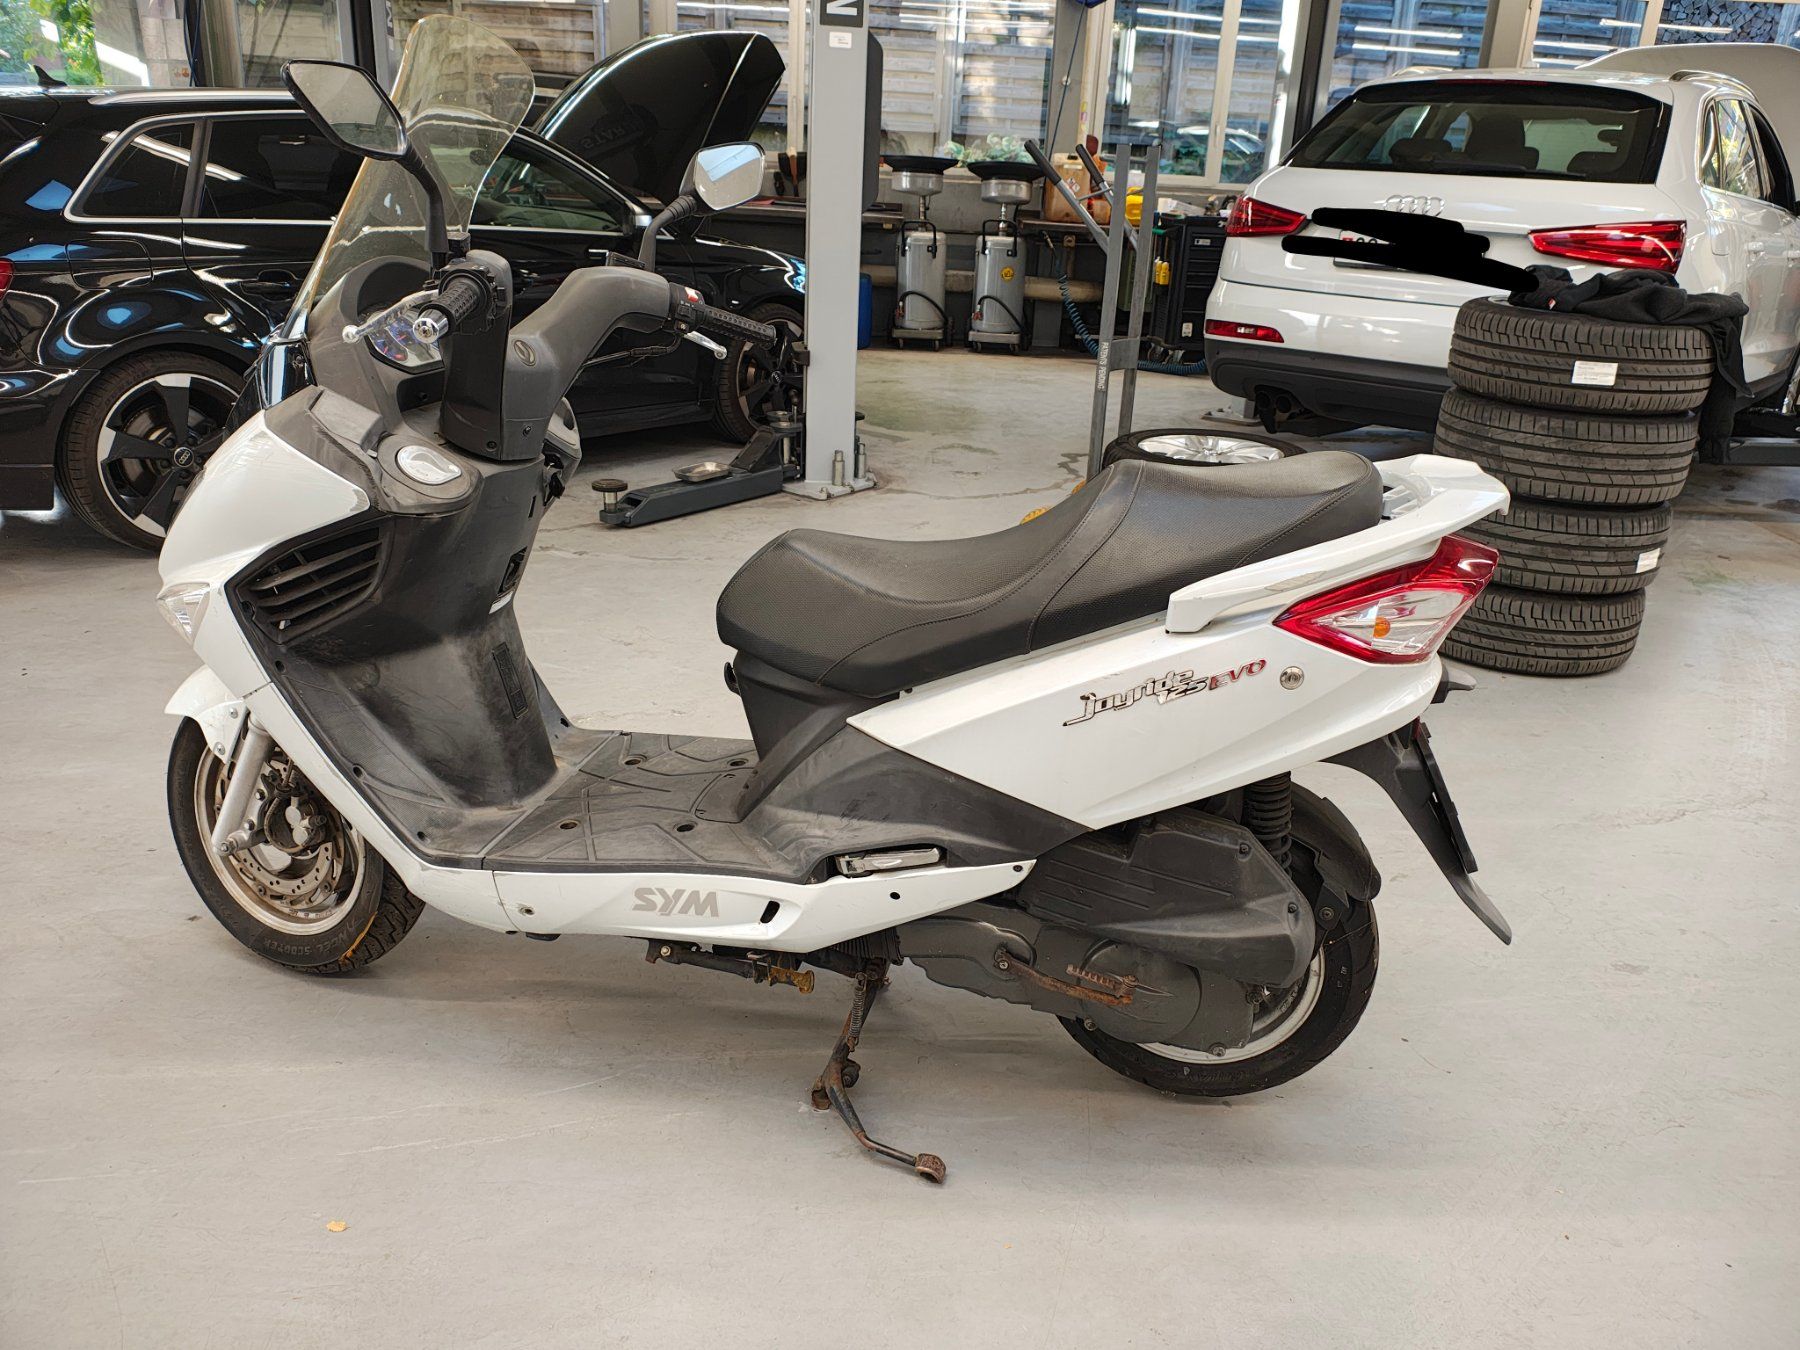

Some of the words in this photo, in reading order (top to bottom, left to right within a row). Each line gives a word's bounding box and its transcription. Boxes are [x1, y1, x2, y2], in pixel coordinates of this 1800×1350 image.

[1097, 366, 1108, 390] PENDING
[1158, 677, 1209, 705] 125
[1209, 659, 1266, 690] EVO
[632, 887, 719, 917] SYM
